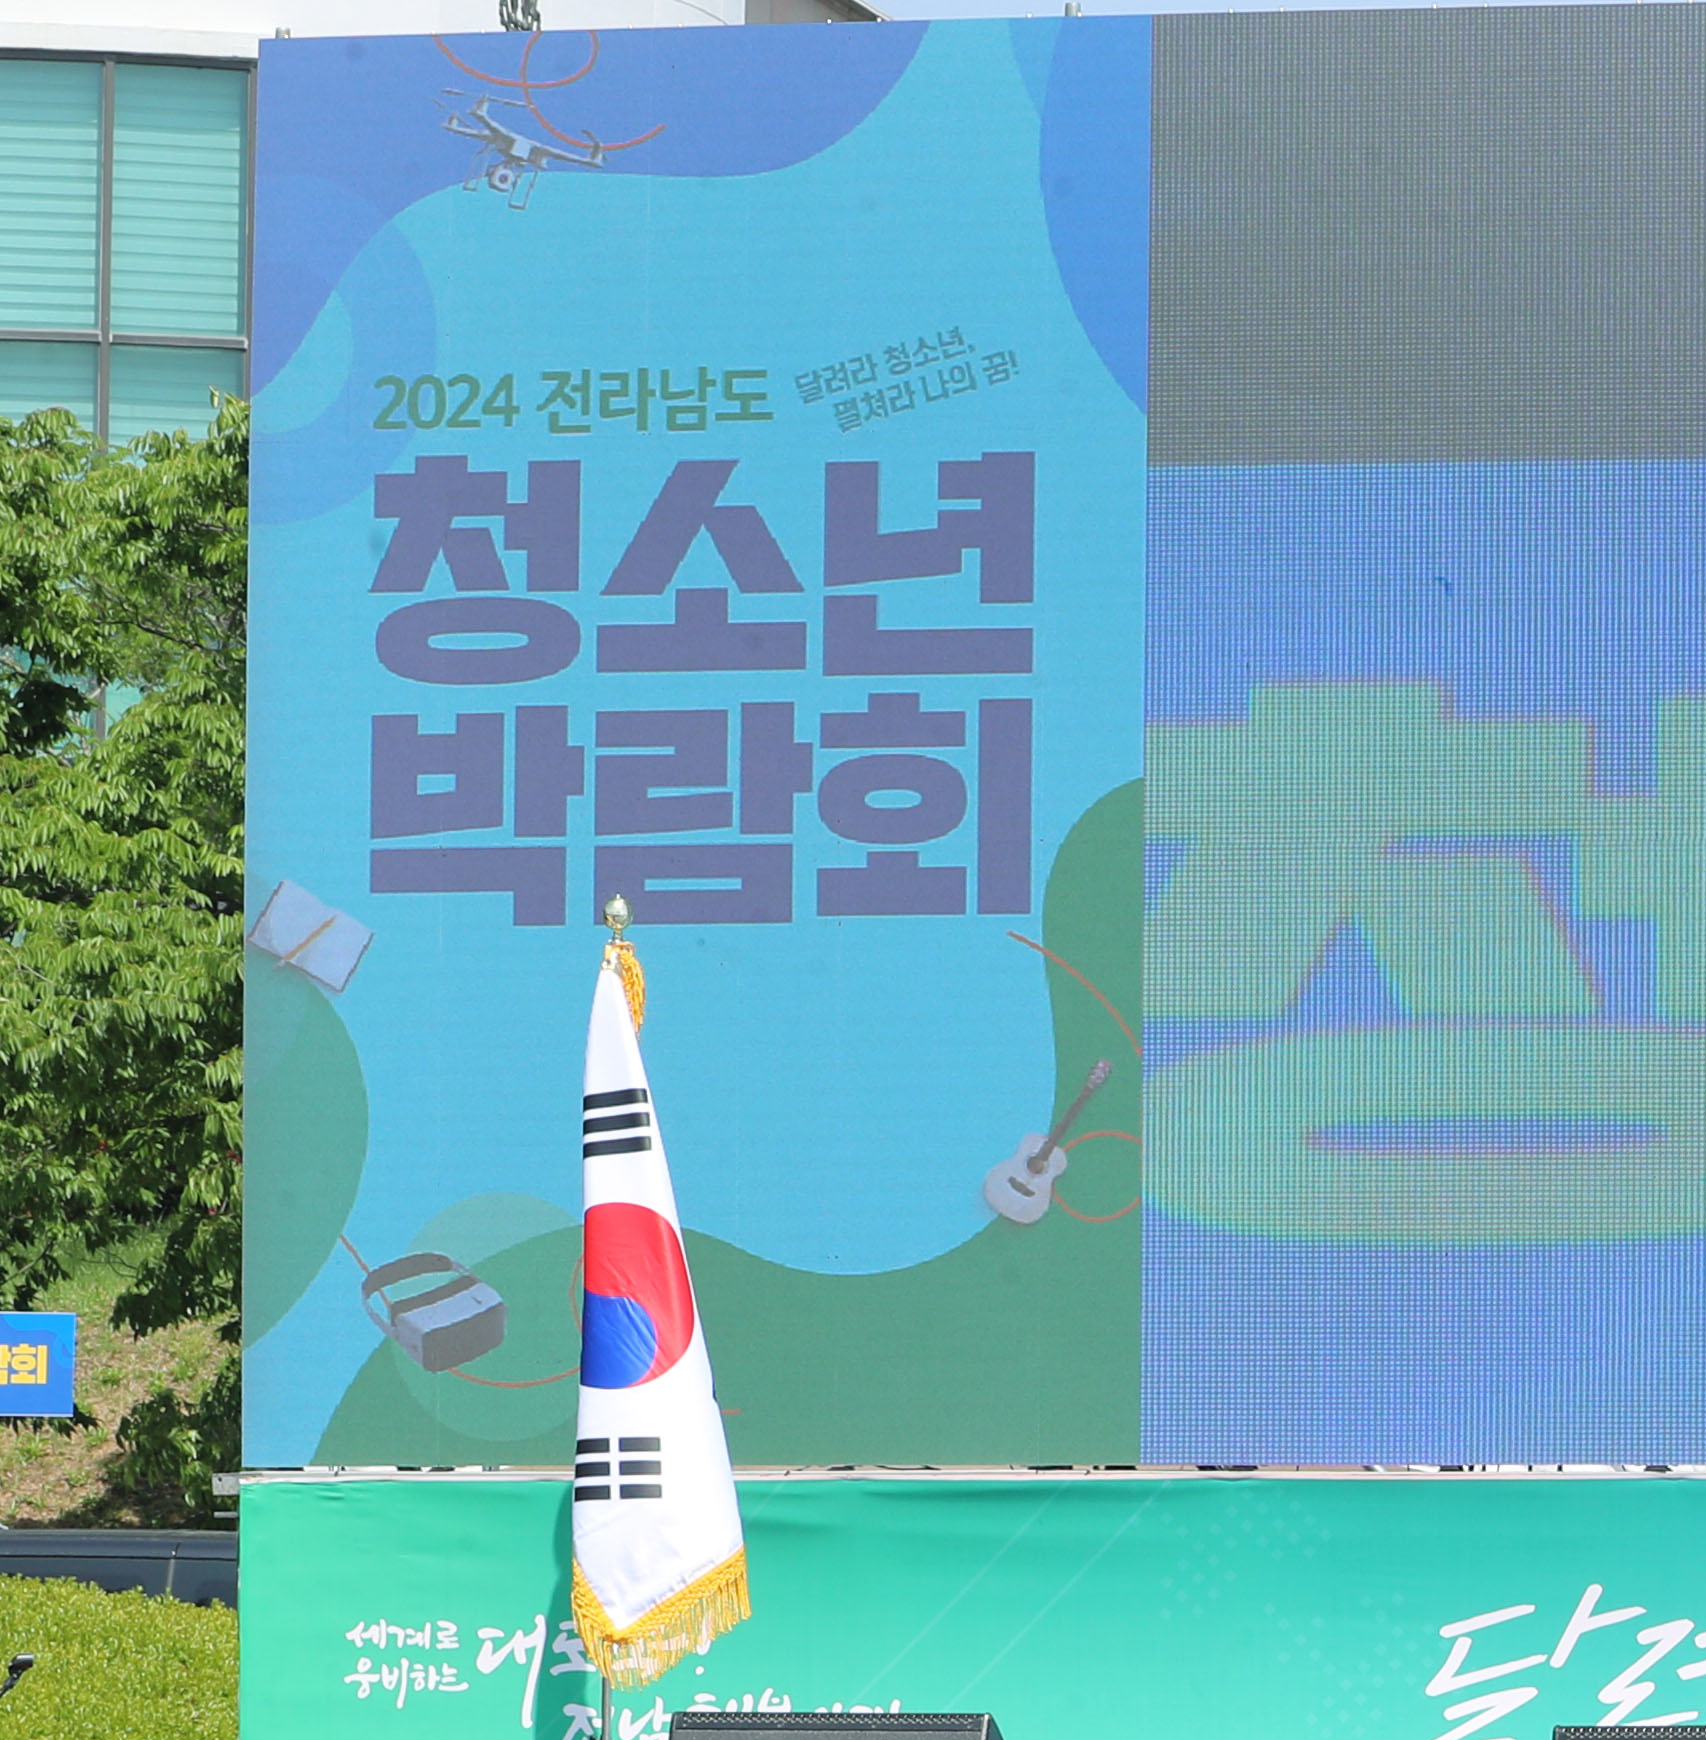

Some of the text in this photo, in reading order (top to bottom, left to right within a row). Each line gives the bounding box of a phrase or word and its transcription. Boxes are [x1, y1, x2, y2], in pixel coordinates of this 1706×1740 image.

[372, 366, 775, 434] 2024 전라남도
[794, 325, 976, 404] 달려라 청소년,
[832, 350, 1020, 433] 펼쳐라 나의 꿈!
[368, 451, 1036, 686] 청소년
[369, 691, 1034, 927] 박람회
[0, 1343, 49, 1386] 회
[345, 1618, 460, 1650] 세계로
[343, 1656, 470, 1710] 웅비하는
